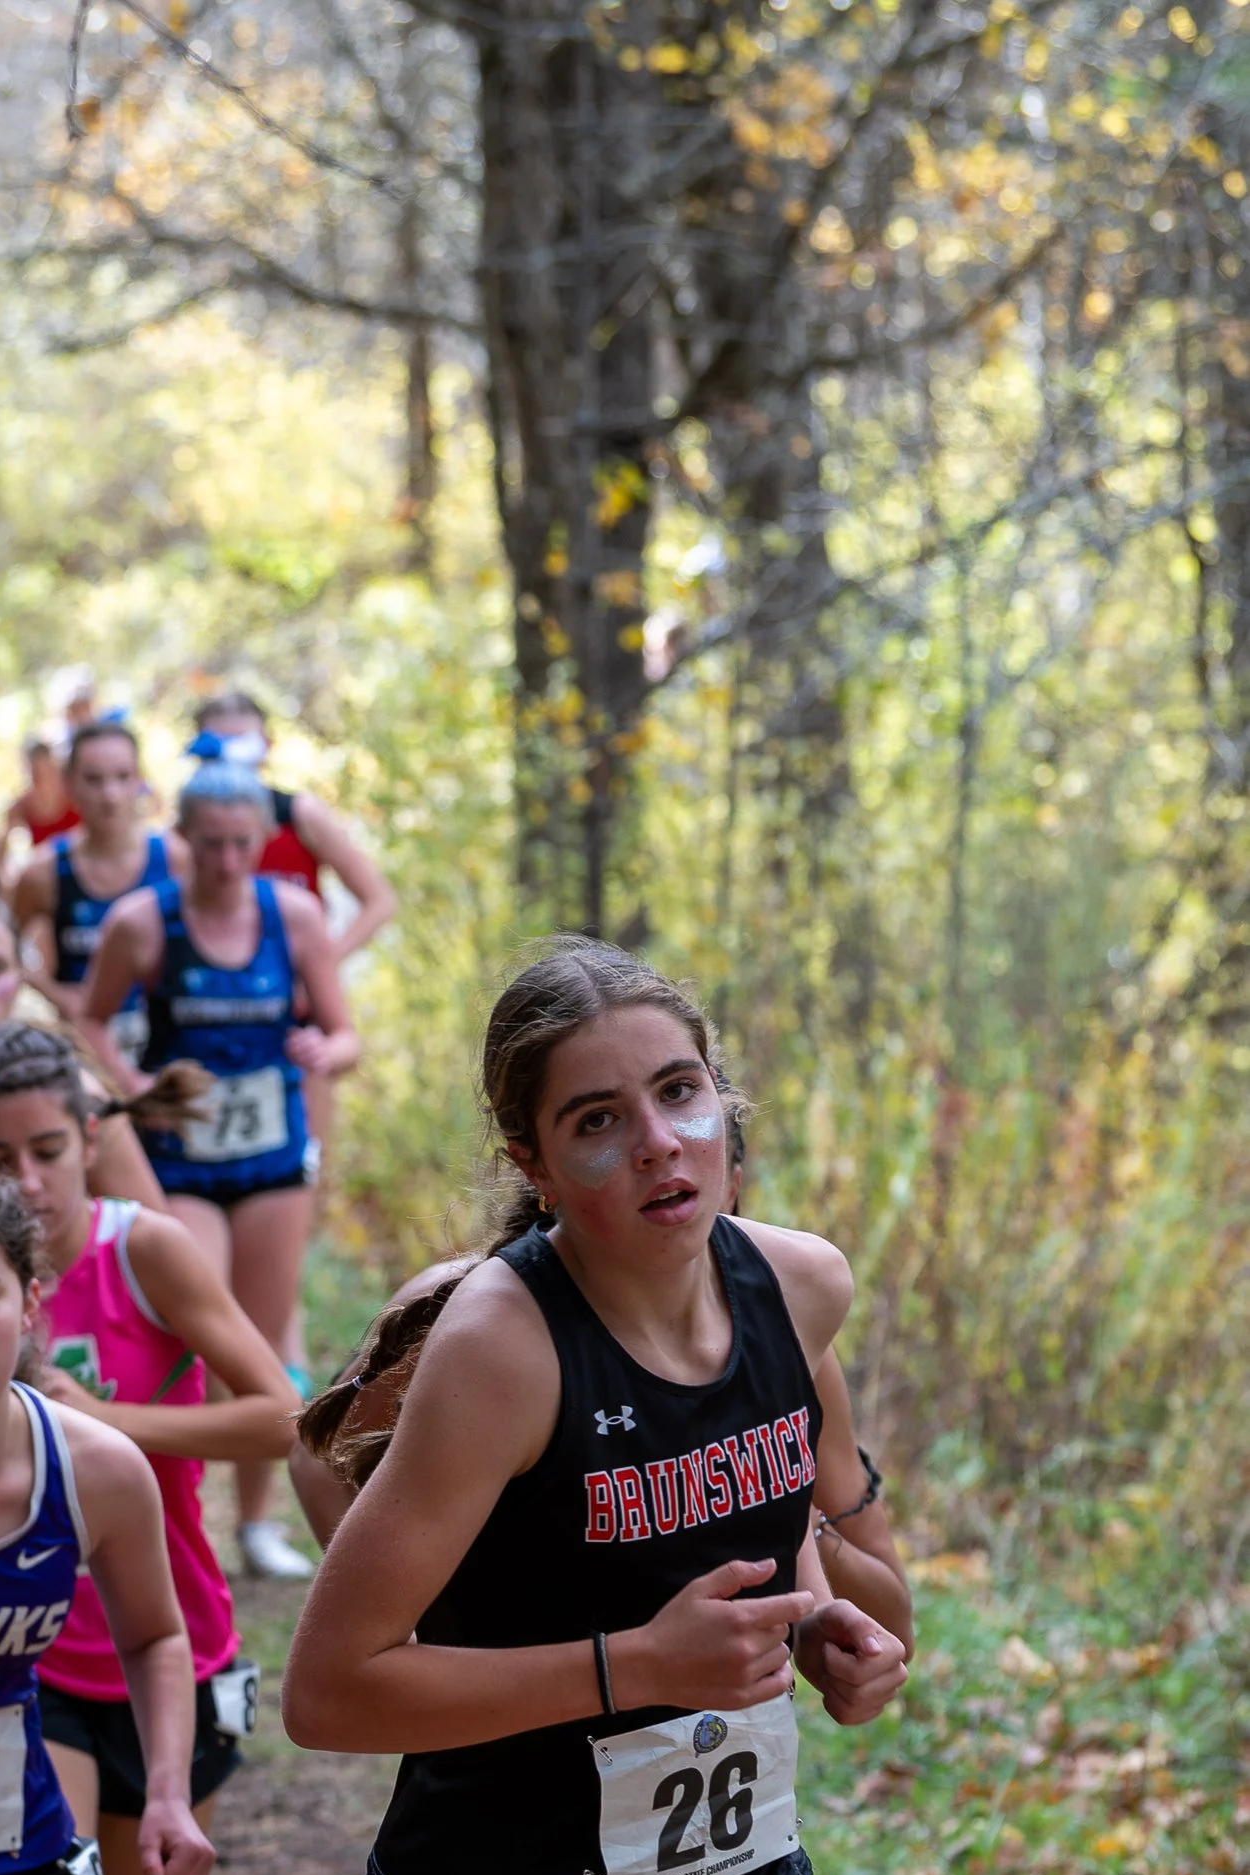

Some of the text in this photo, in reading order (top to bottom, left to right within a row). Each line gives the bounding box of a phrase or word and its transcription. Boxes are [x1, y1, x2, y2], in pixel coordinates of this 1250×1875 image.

[584, 1406, 816, 1542] BRUNSWICK
[652, 1750, 758, 1873] 26
[706, 1848, 756, 1875] CHAMPIONSHIP
